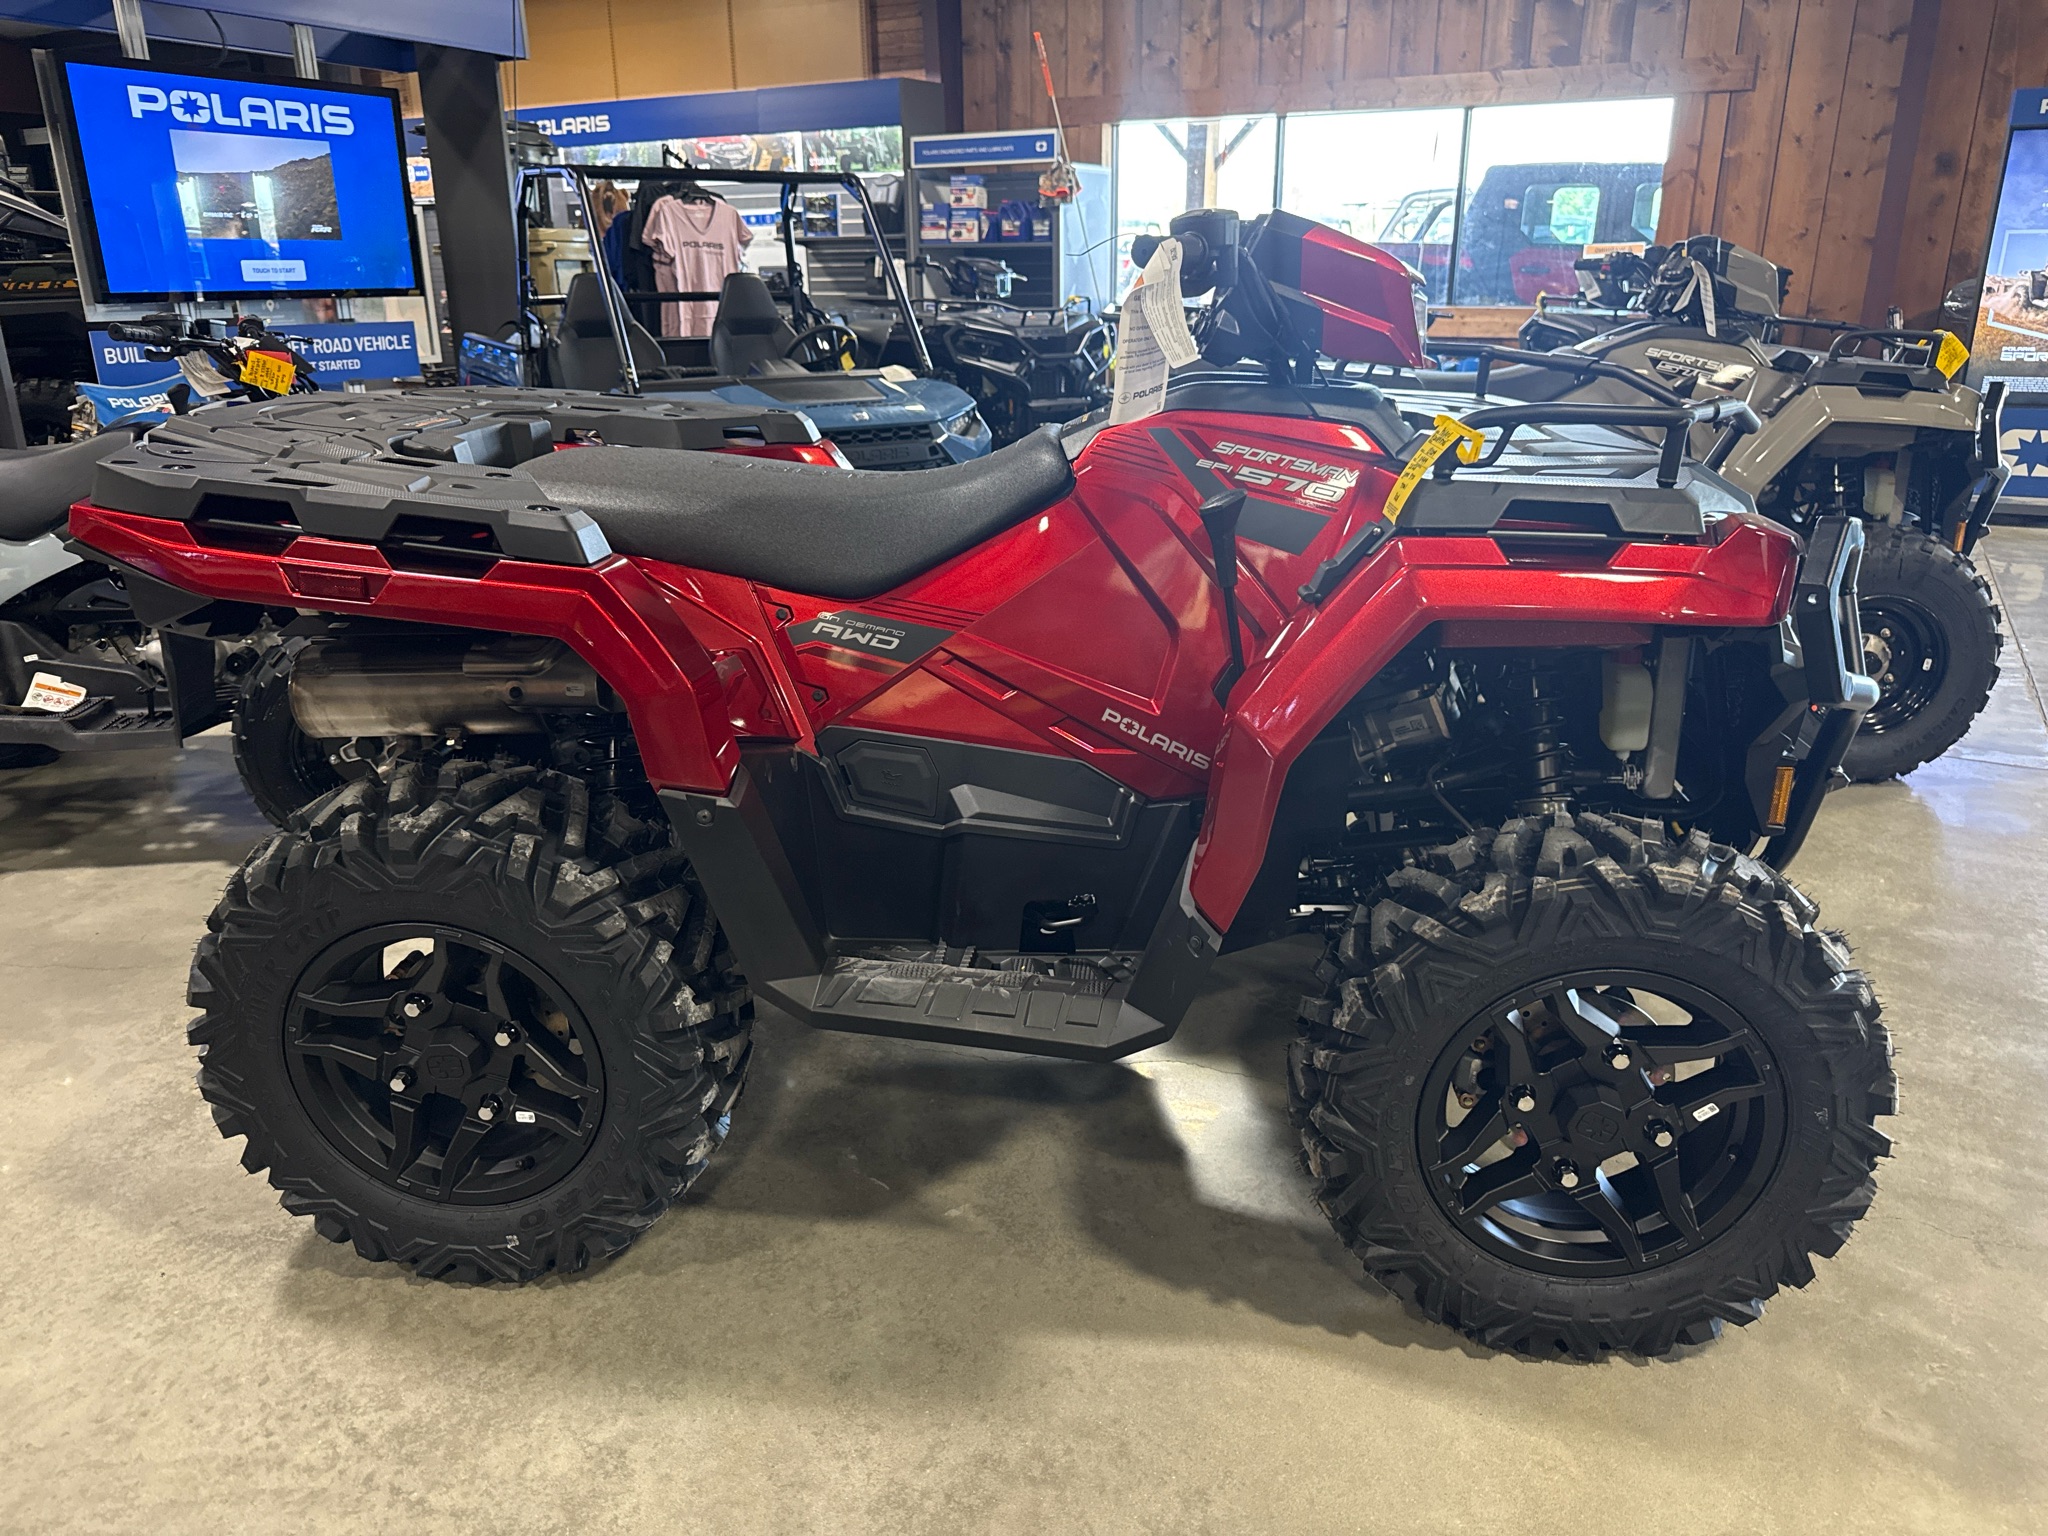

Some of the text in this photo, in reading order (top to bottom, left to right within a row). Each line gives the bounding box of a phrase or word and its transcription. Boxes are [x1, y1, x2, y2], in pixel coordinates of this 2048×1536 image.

[127, 85, 354, 136] POLARIS
[532, 115, 611, 136] OLARIS
[682, 240, 725, 250] POLARIS
[103, 345, 157, 365] BUIL
[287, 334, 412, 355] FF ROAD VEHICLE
[318, 358, 361, 372] STARTED
[107, 392, 170, 409] POLARI
[1133, 383, 1164, 400] POLARIS
[1212, 441, 1359, 483] SPORTSMAN
[1195, 458, 1346, 503] EFI 570
[812, 621, 900, 650] AWD
[1101, 707, 1211, 770] POLARIS
